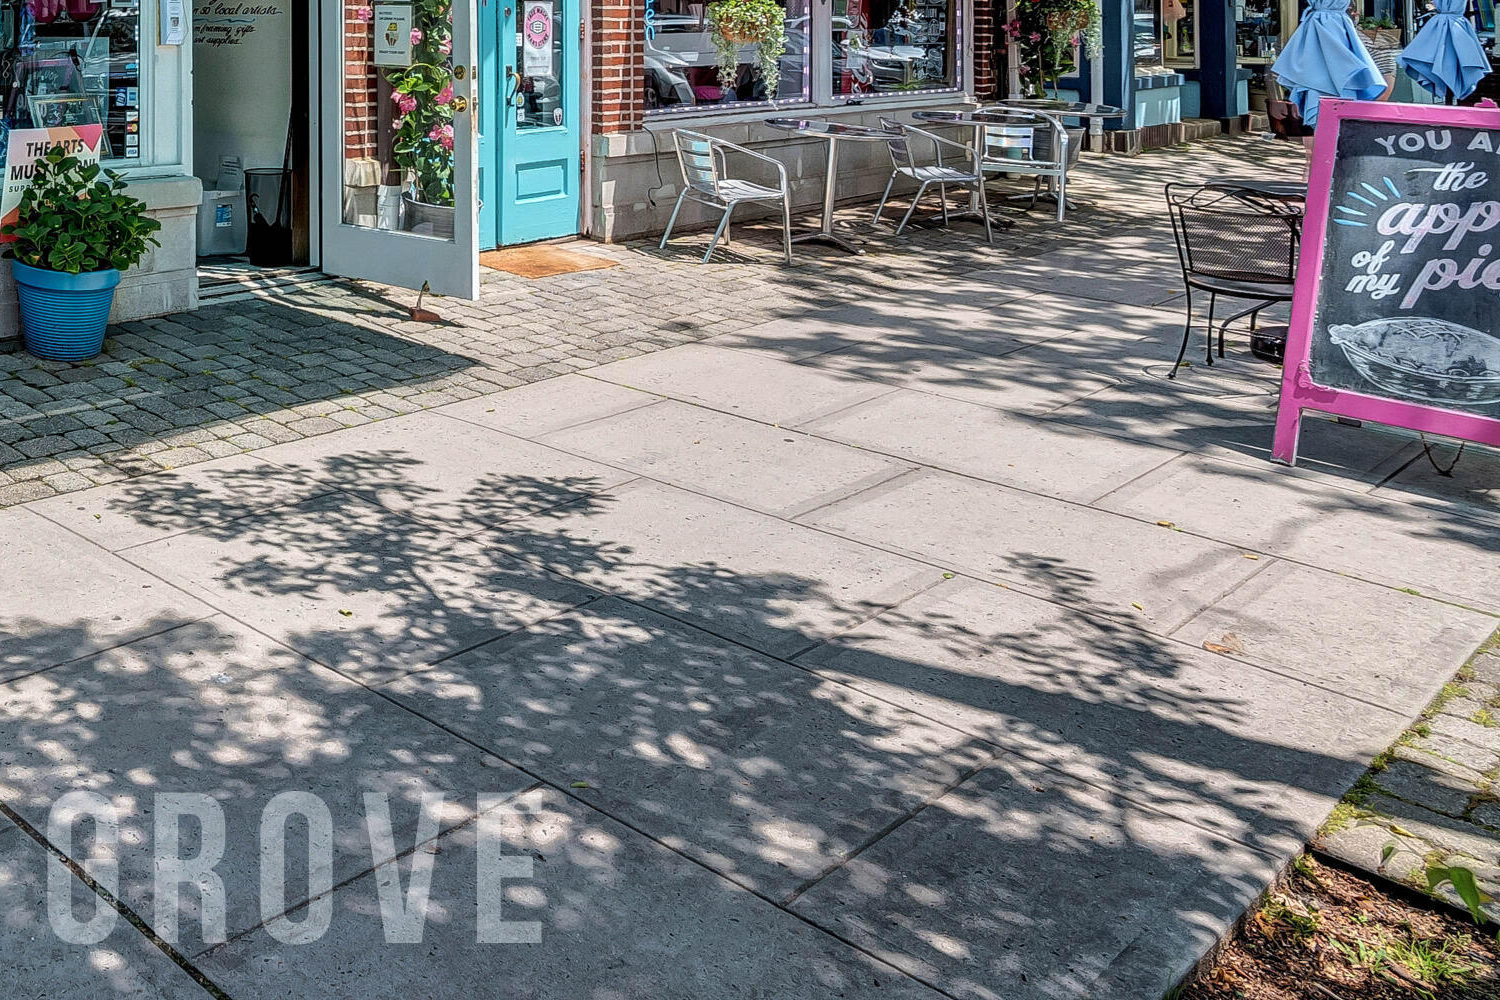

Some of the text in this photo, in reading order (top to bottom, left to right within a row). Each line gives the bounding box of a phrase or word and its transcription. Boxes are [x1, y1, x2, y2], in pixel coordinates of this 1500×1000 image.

[215, 2, 242, 15] local
[27, 141, 51, 157] THE
[1374, 129, 1500, 156] YOU A
[1404, 161, 1489, 192] the
[1351, 240, 1395, 275] of
[1345, 272, 1400, 299] my
